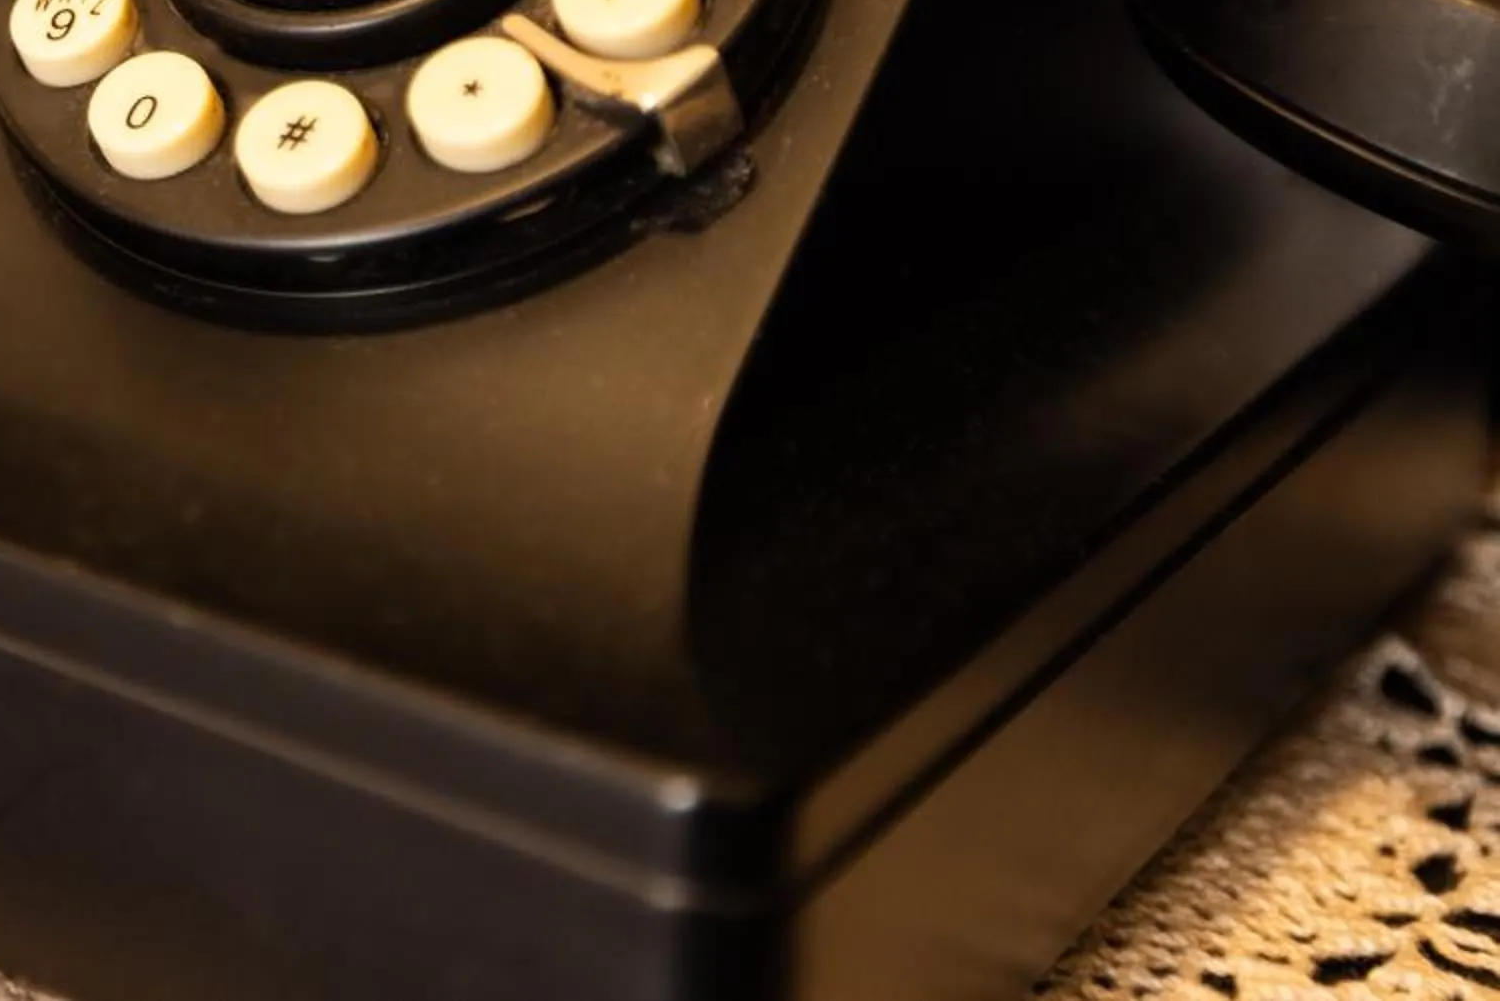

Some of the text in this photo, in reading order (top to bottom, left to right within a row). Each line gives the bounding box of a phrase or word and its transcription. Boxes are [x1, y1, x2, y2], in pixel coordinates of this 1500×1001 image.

[46, 7, 77, 41] 9
[125, 95, 158, 130] 0
[276, 113, 318, 151] #
